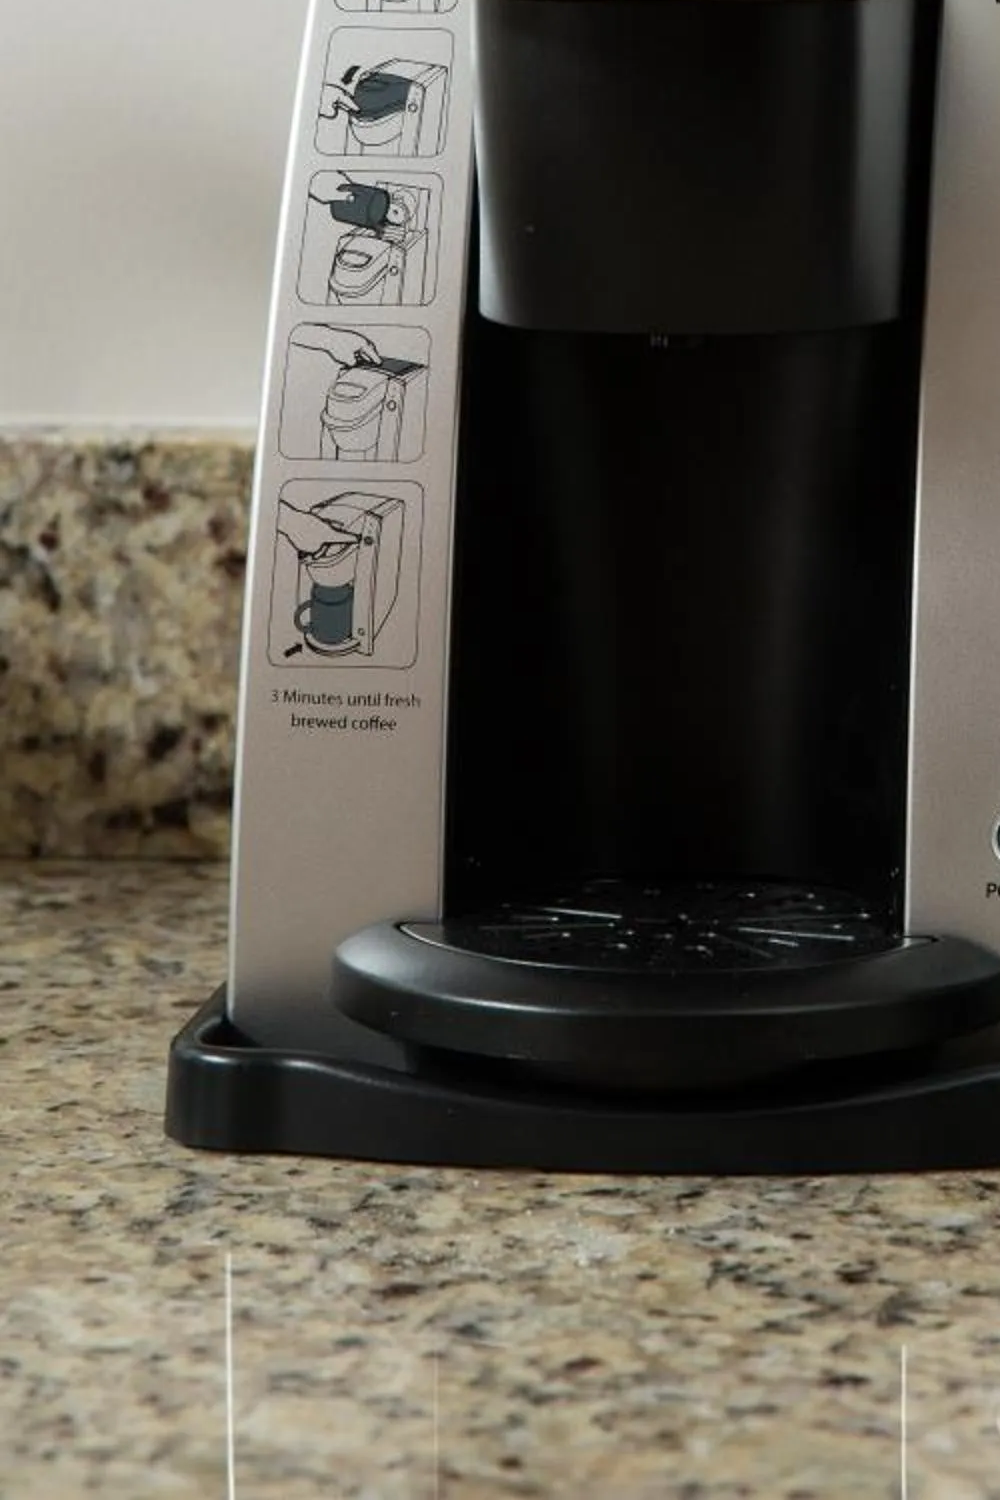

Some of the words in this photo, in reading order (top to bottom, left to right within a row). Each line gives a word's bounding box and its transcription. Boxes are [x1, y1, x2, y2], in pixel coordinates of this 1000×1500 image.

[271, 690, 279, 703] 3
[283, 690, 343, 706] Minutes
[347, 692, 381, 707] until
[384, 693, 421, 708] fresh
[291, 713, 347, 729] brewed
[351, 715, 397, 731] coffee
